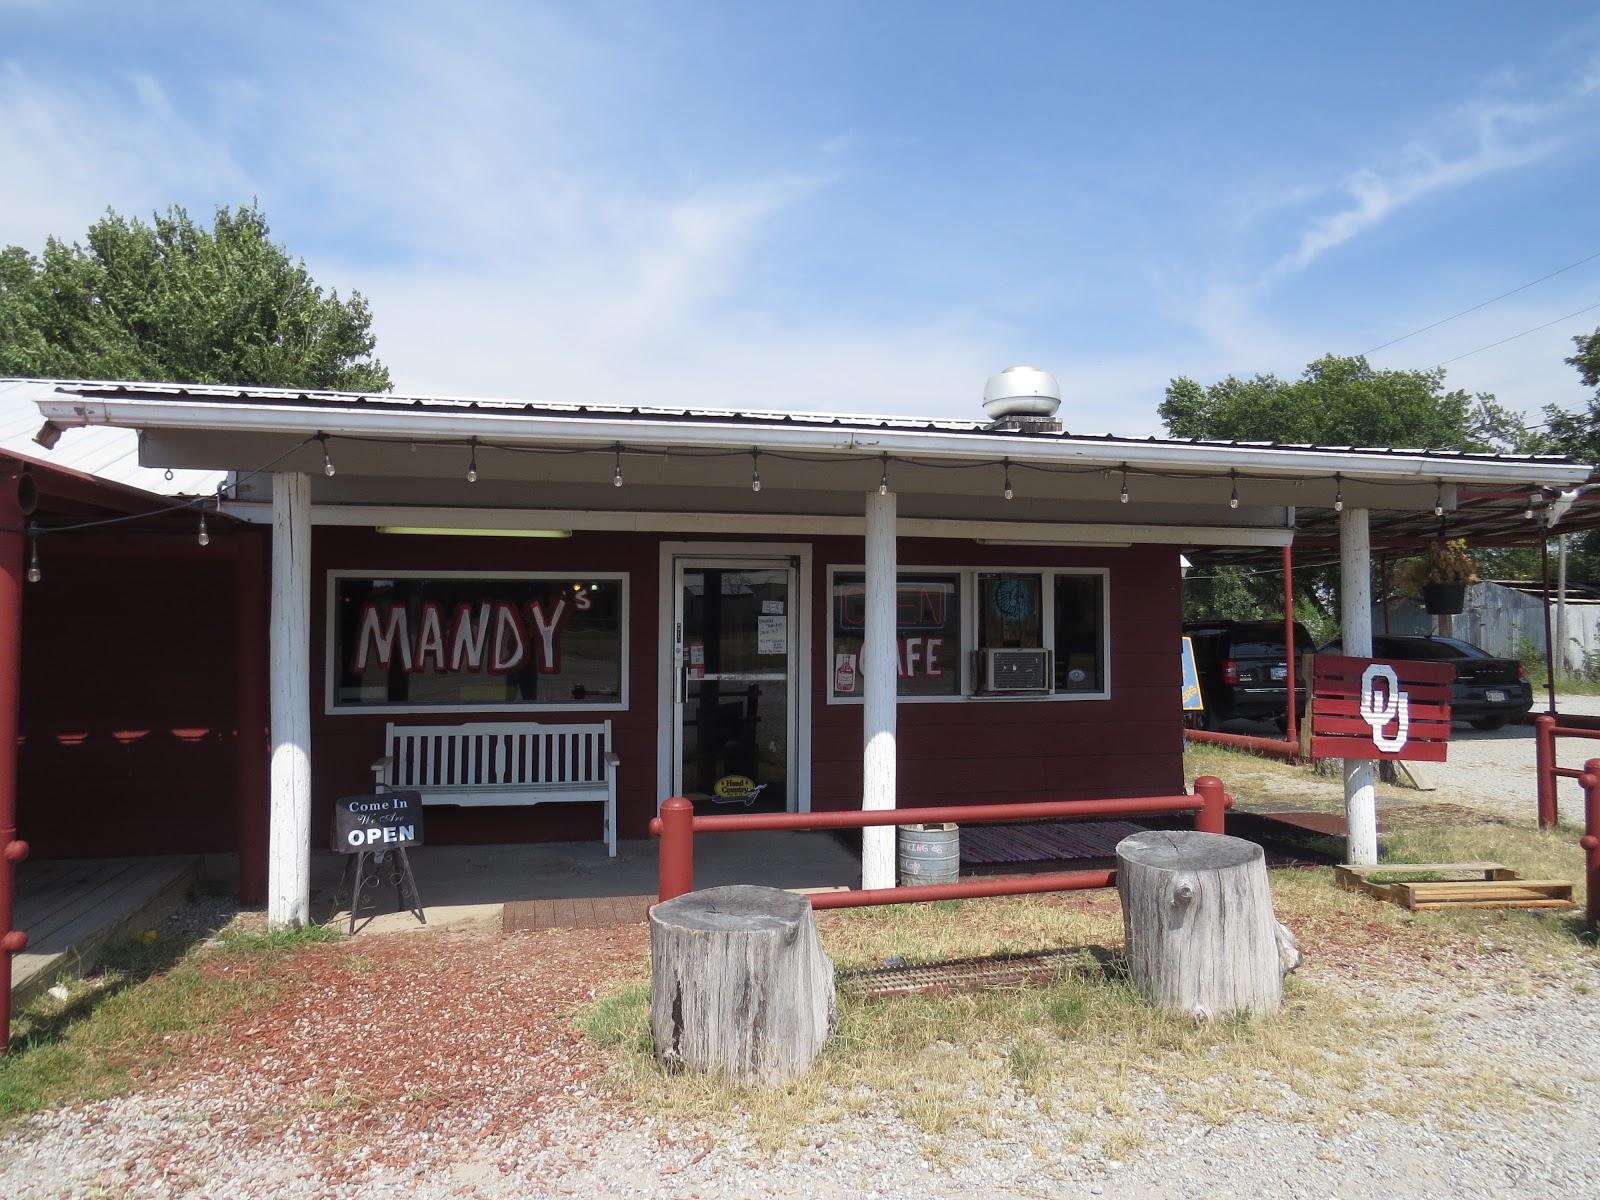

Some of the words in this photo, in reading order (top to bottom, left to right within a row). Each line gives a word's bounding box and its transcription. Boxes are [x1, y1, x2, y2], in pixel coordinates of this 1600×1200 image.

[844, 586, 942, 625] OEN
[349, 802, 389, 813] Come
[393, 798, 408, 809] In
[357, 812, 376, 826] We
[379, 811, 405, 823] Are
[347, 824, 415, 846] OPEN
